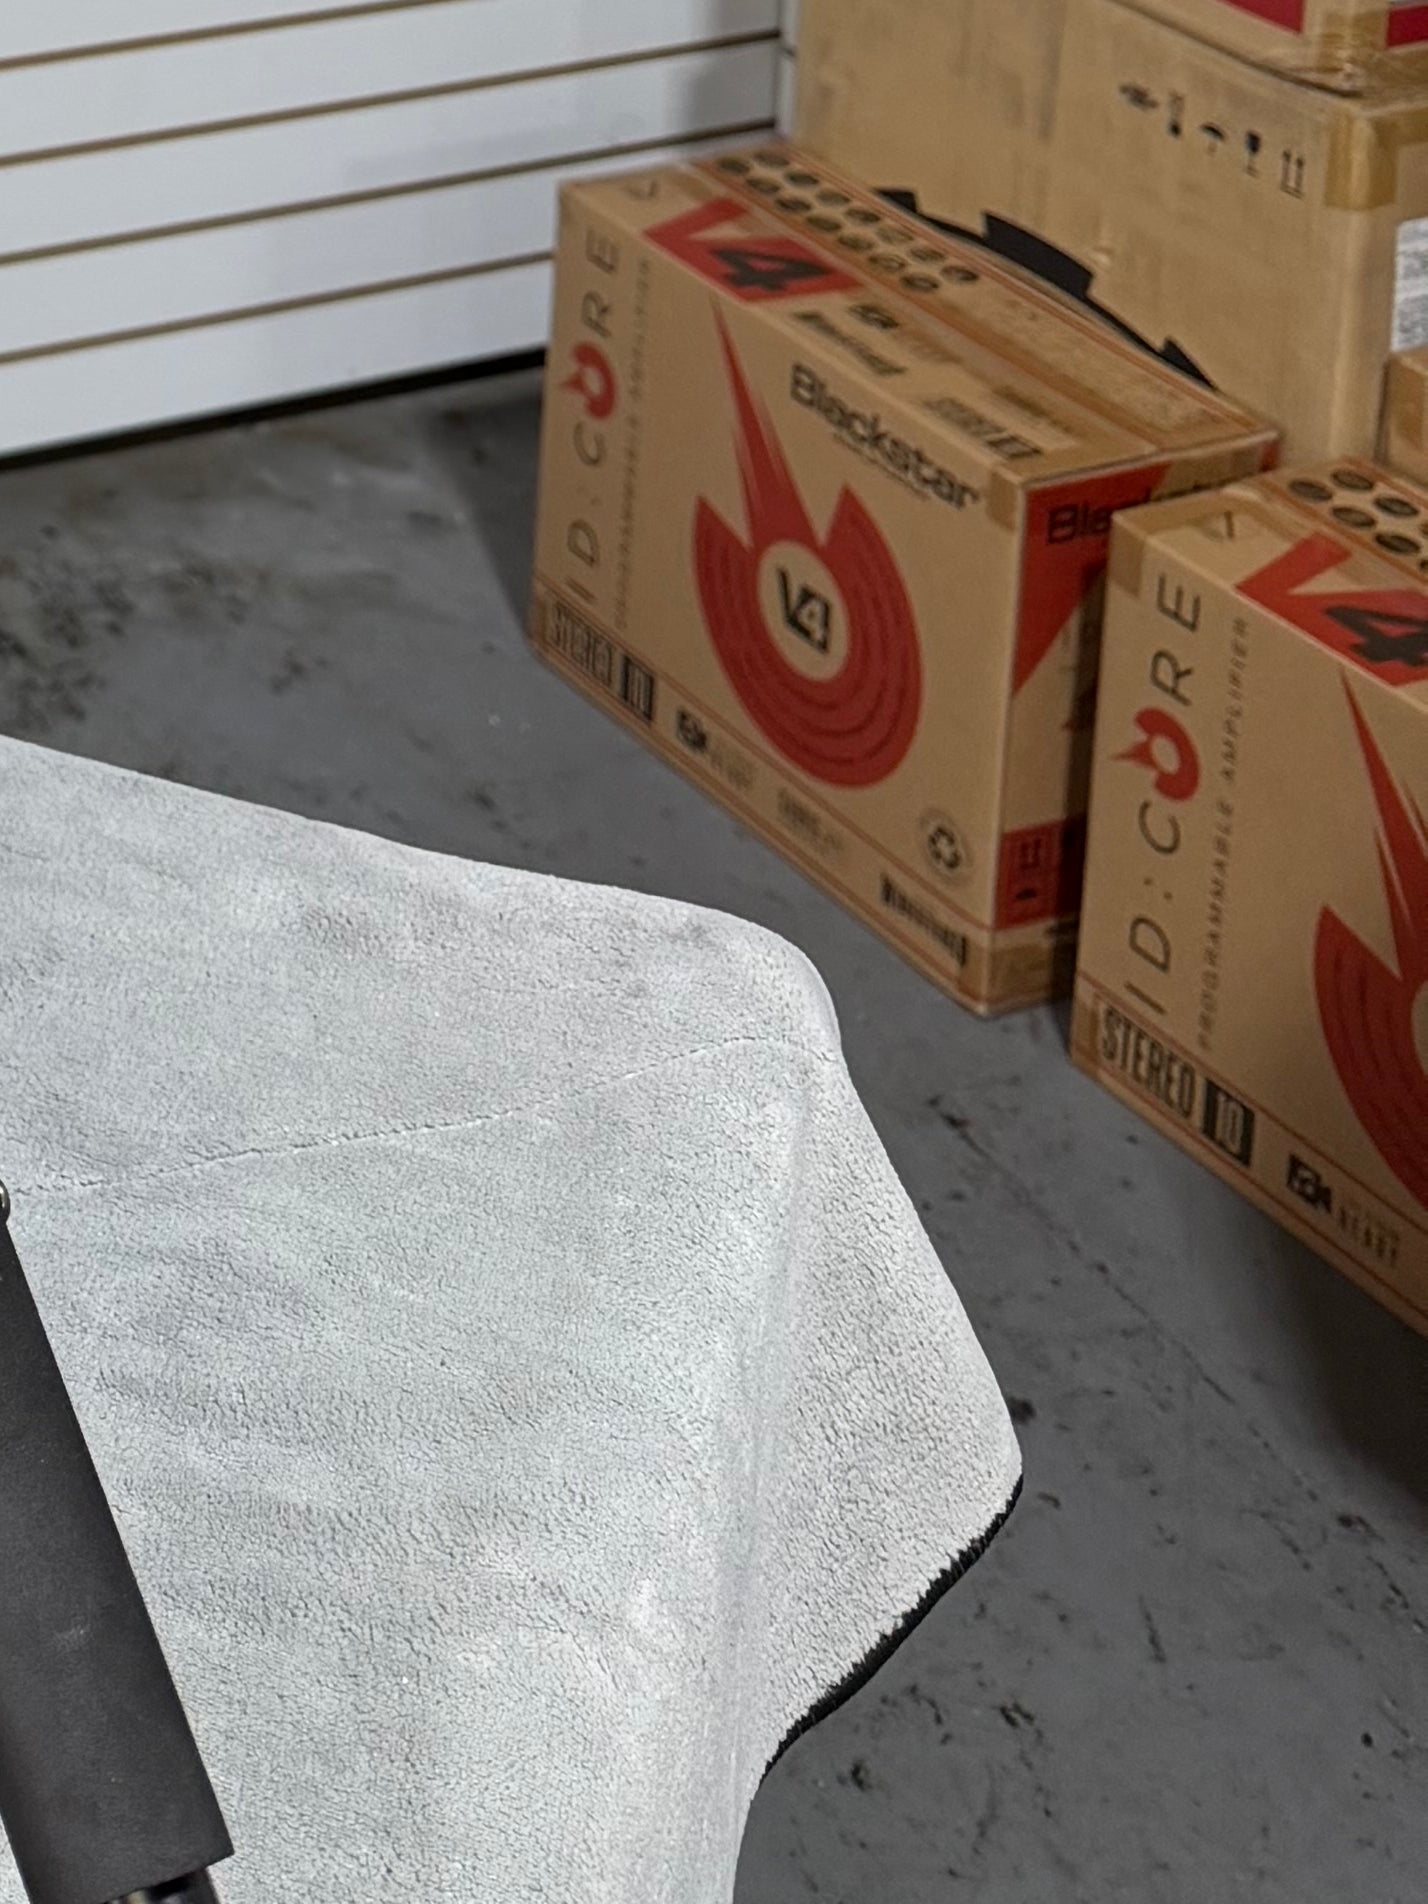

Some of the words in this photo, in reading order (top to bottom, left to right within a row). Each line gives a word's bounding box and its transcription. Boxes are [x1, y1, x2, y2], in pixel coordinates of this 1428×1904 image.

[791, 362, 980, 511] Blackstar
[551, 598, 614, 689] STEREO
[1100, 1005, 1197, 1120] STEREO
